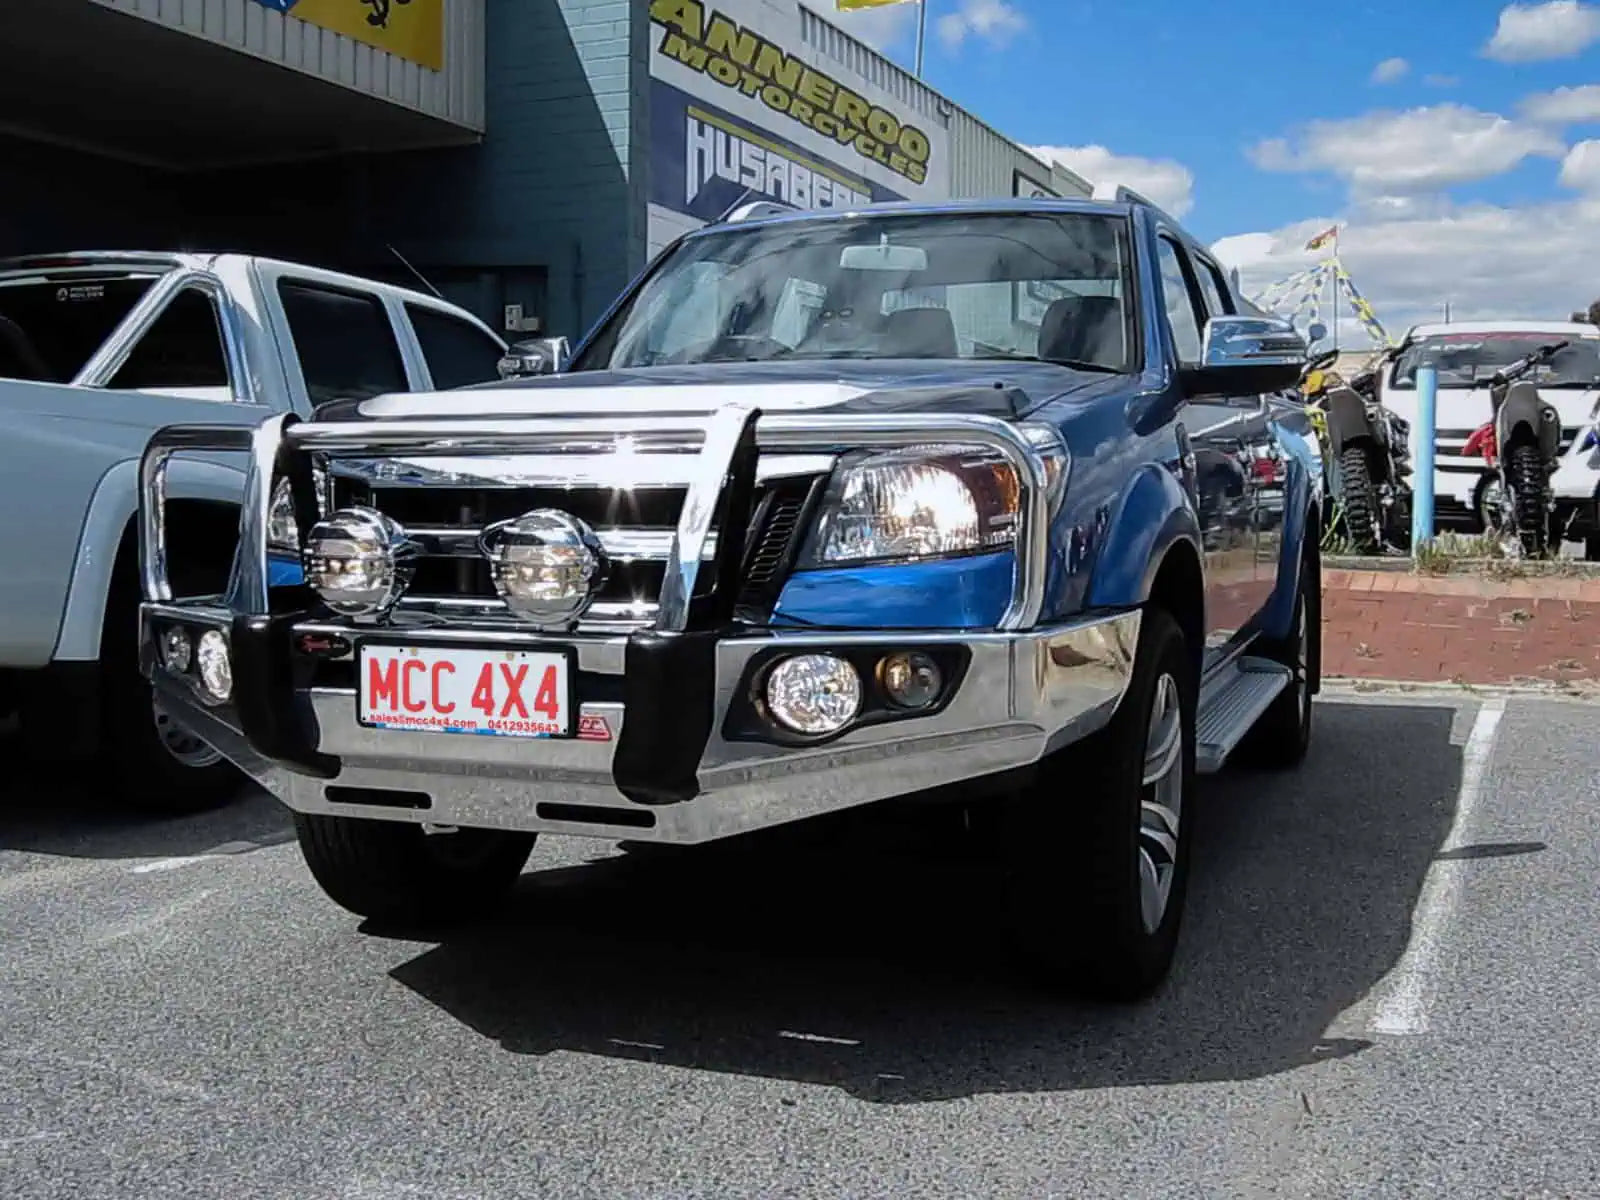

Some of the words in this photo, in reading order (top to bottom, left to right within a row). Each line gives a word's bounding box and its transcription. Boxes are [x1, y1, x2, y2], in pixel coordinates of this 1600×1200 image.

[661, 35, 928, 184] MOTORCYCLES
[369, 656, 456, 714] MCC
[471, 662, 560, 720] 4X4
